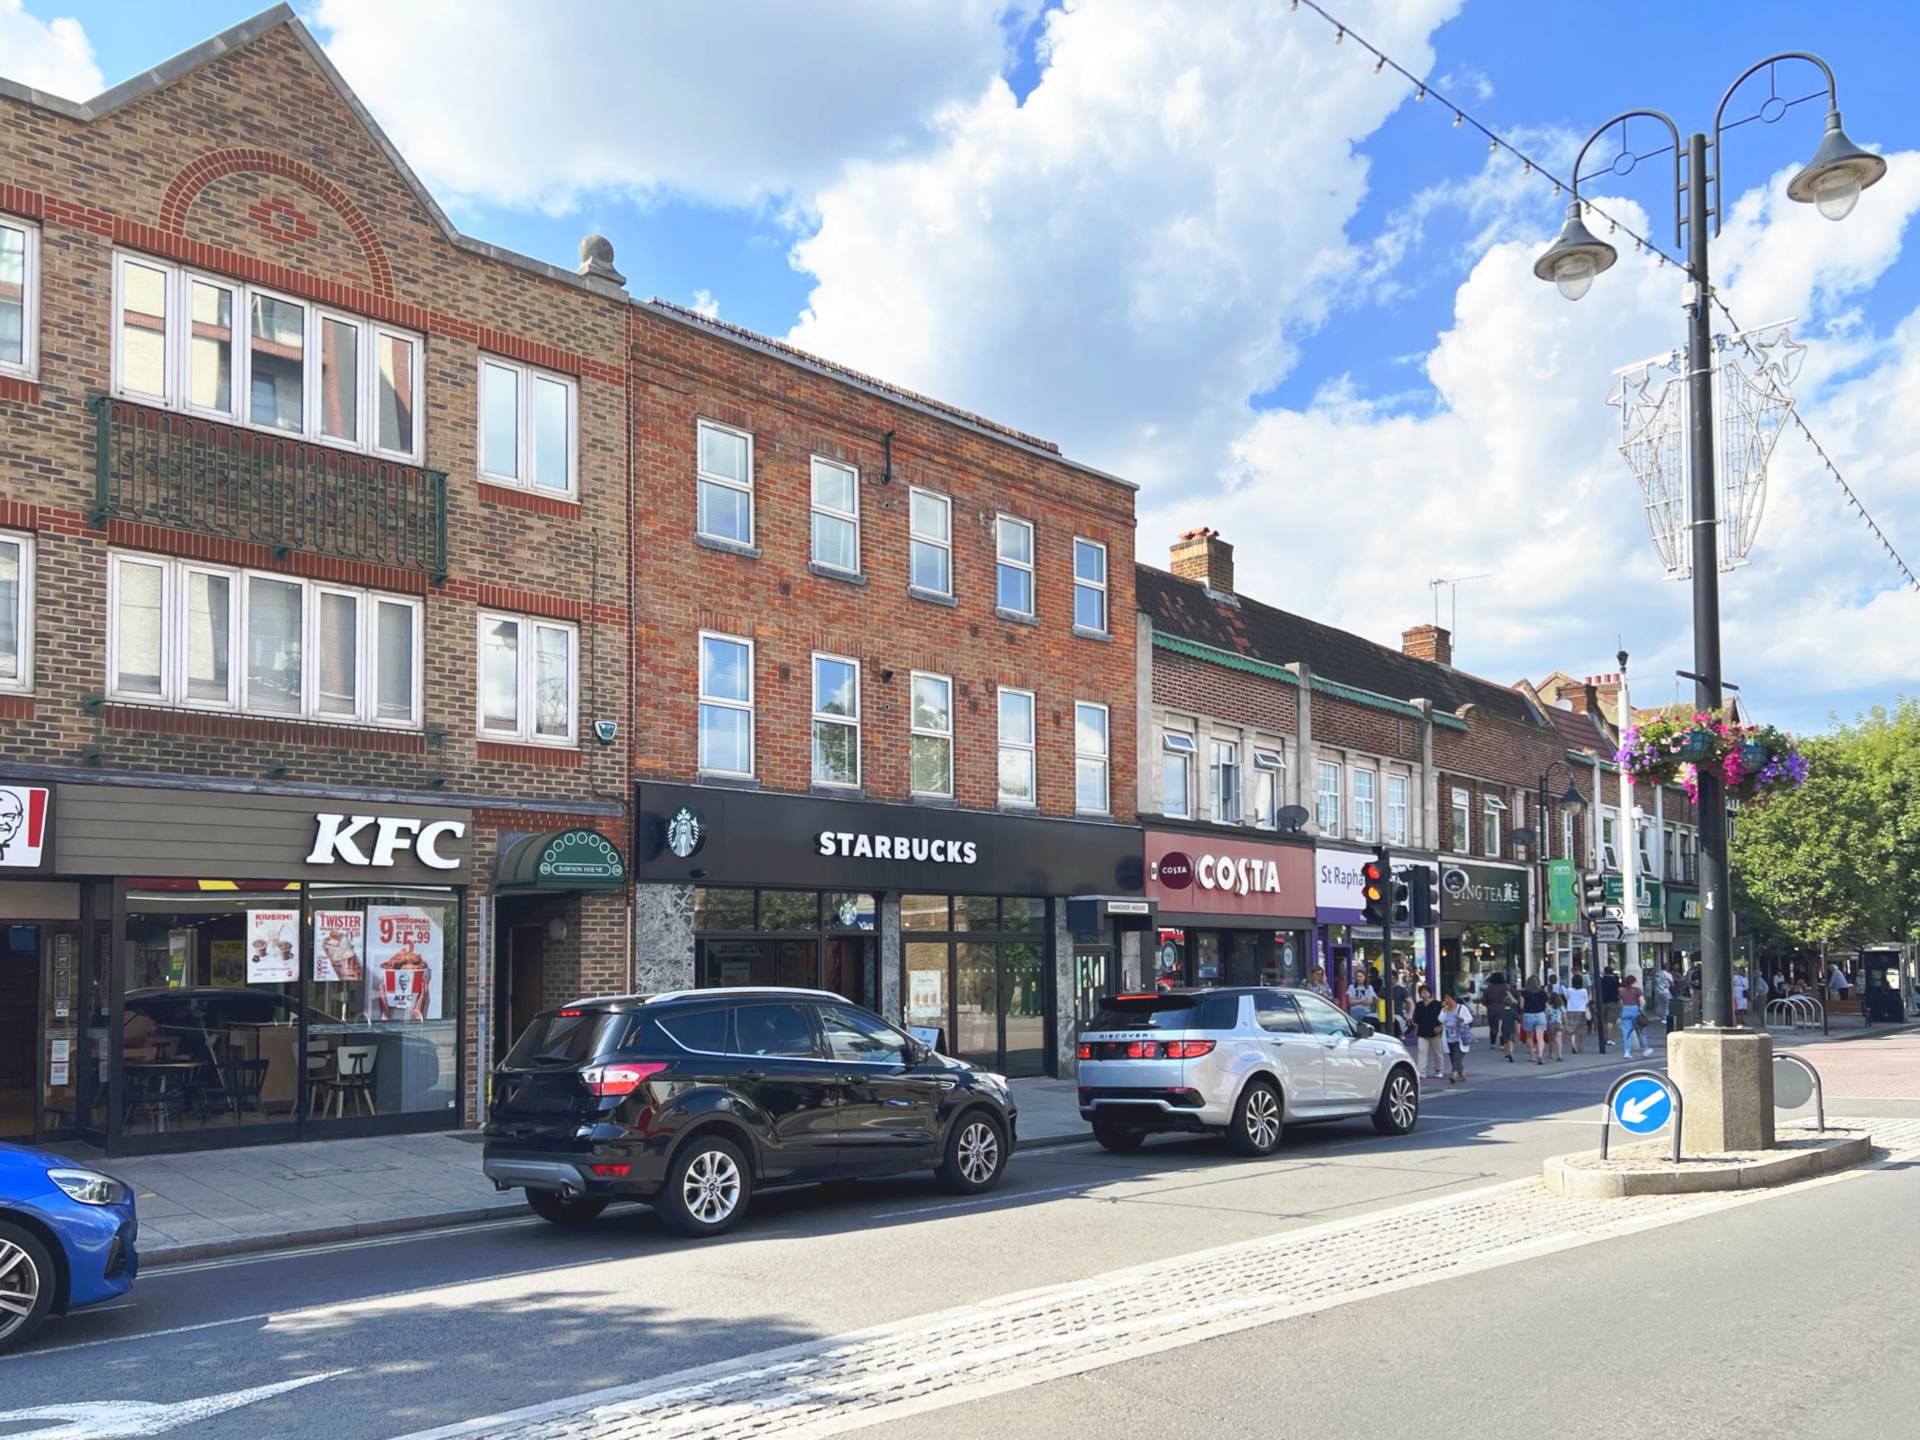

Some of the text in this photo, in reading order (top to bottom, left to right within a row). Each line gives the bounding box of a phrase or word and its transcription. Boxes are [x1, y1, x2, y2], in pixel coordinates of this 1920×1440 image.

[306, 813, 465, 869] KFC
[819, 831, 977, 864] STARBUCKS
[1162, 866, 1188, 874] COSTA
[1197, 854, 1281, 896] COSTA
[1321, 865, 1364, 889] St Rapha
[1483, 886, 1503, 902] TEA
[320, 915, 360, 927] TWISTER
[380, 918, 394, 944] 9
[396, 931, 431, 950] £5.99
